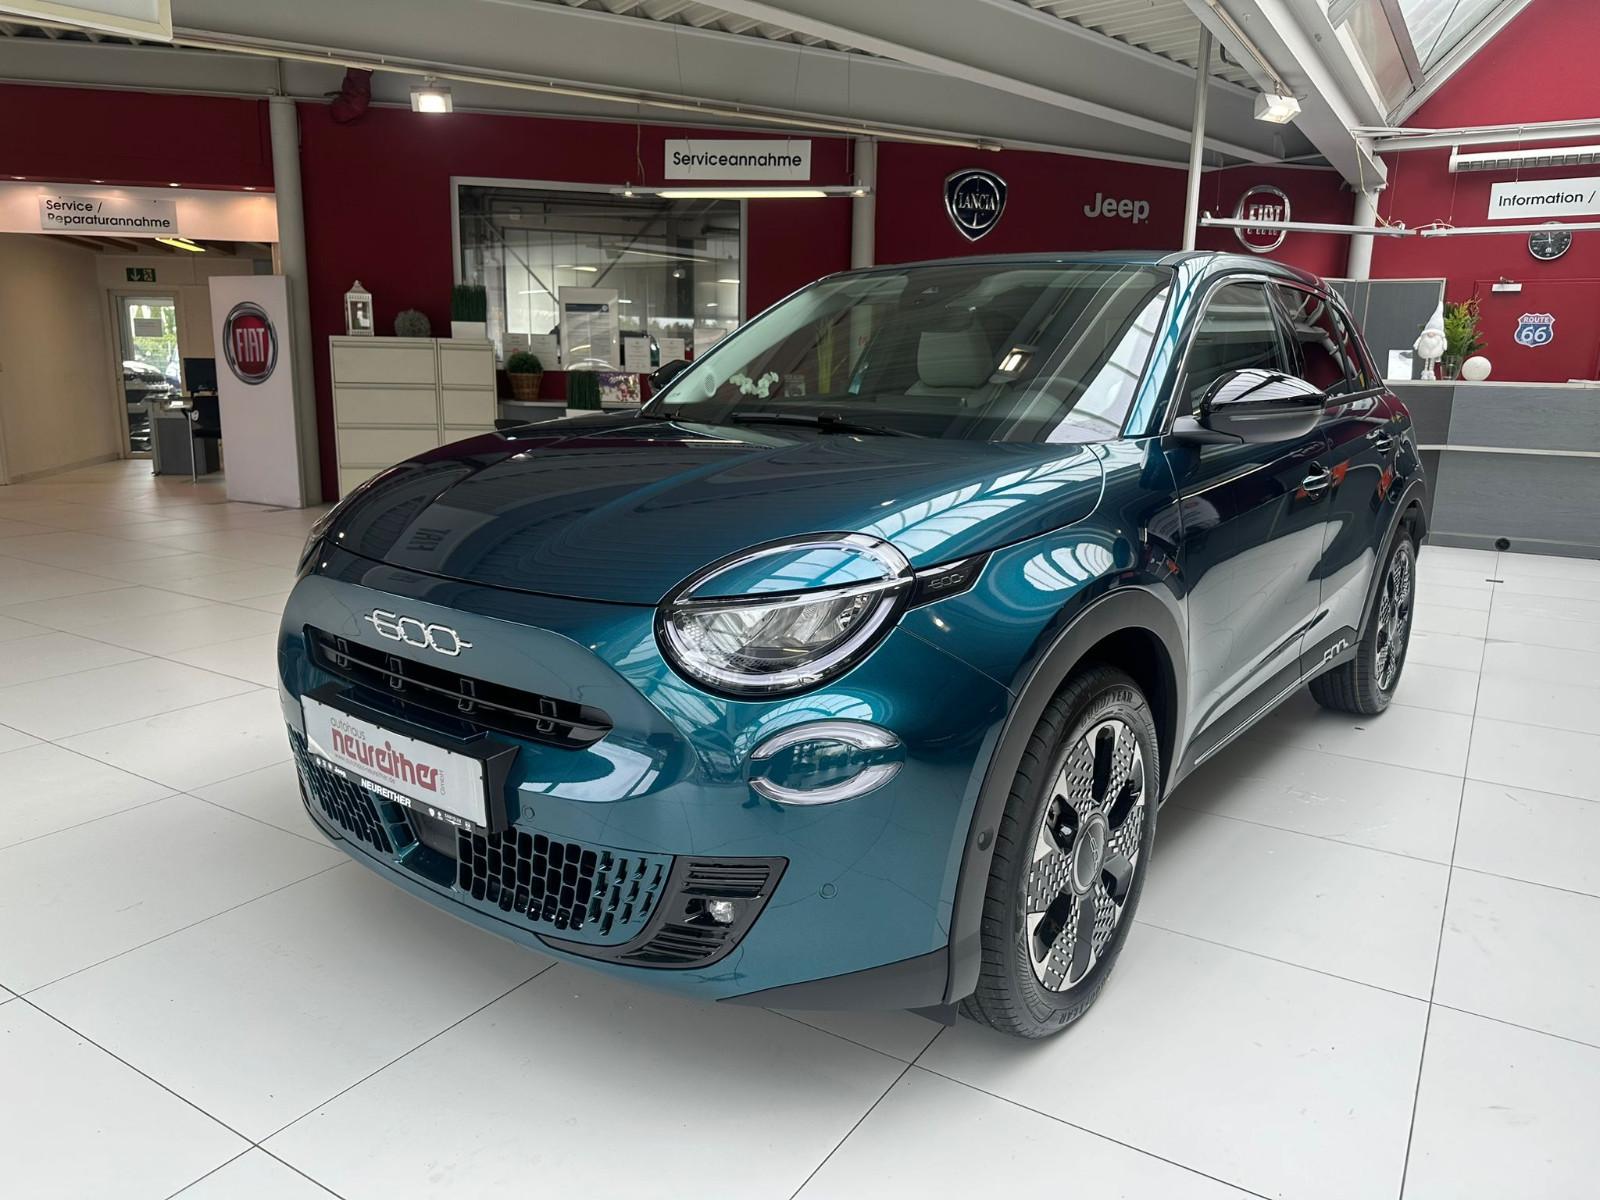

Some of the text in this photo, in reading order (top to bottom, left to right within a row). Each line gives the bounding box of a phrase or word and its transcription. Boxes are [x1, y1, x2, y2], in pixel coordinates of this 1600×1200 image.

[672, 151, 802, 167] Serviceannahme
[46, 199, 93, 212] Service
[958, 191, 996, 211] LANCIA
[1083, 192, 1150, 224] Jeep
[1498, 192, 1584, 207] Information
[47, 212, 171, 228] Reparaturannahme
[1246, 204, 1283, 236] FIAT
[1521, 326, 1547, 342] 66
[235, 328, 265, 363] FIAT
[928, 573, 964, 589] 600
[365, 608, 472, 657] 600
[331, 727, 438, 793] neureither
[360, 778, 412, 808] NEUREITHER
